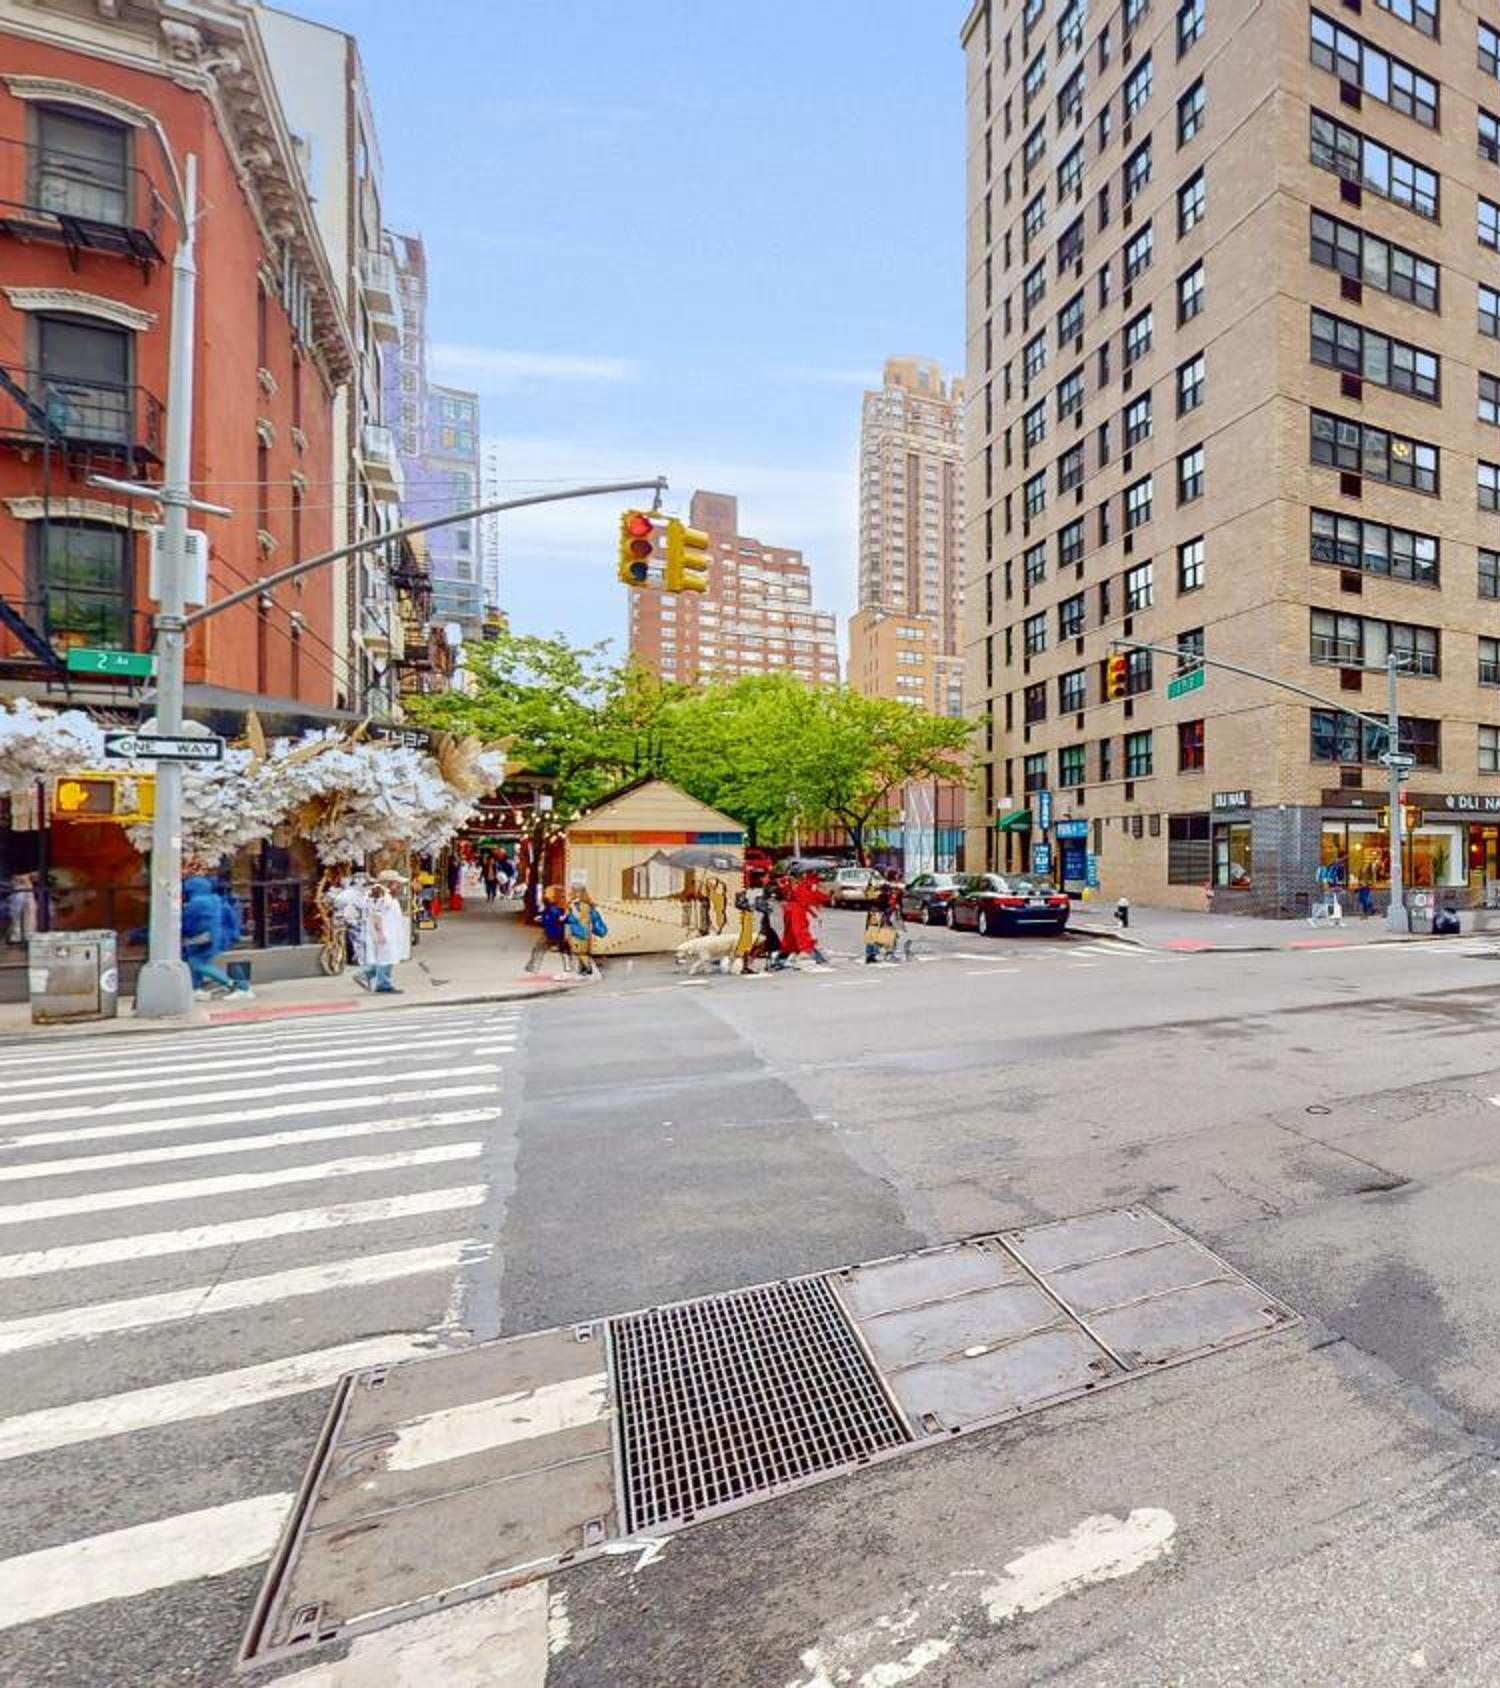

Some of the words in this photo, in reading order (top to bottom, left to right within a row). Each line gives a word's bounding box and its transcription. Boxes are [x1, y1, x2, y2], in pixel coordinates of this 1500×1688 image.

[96, 652, 107, 670] 2
[119, 740, 156, 752] ONE
[176, 742, 213, 753] WAY
[1458, 795, 1479, 809] DLI
